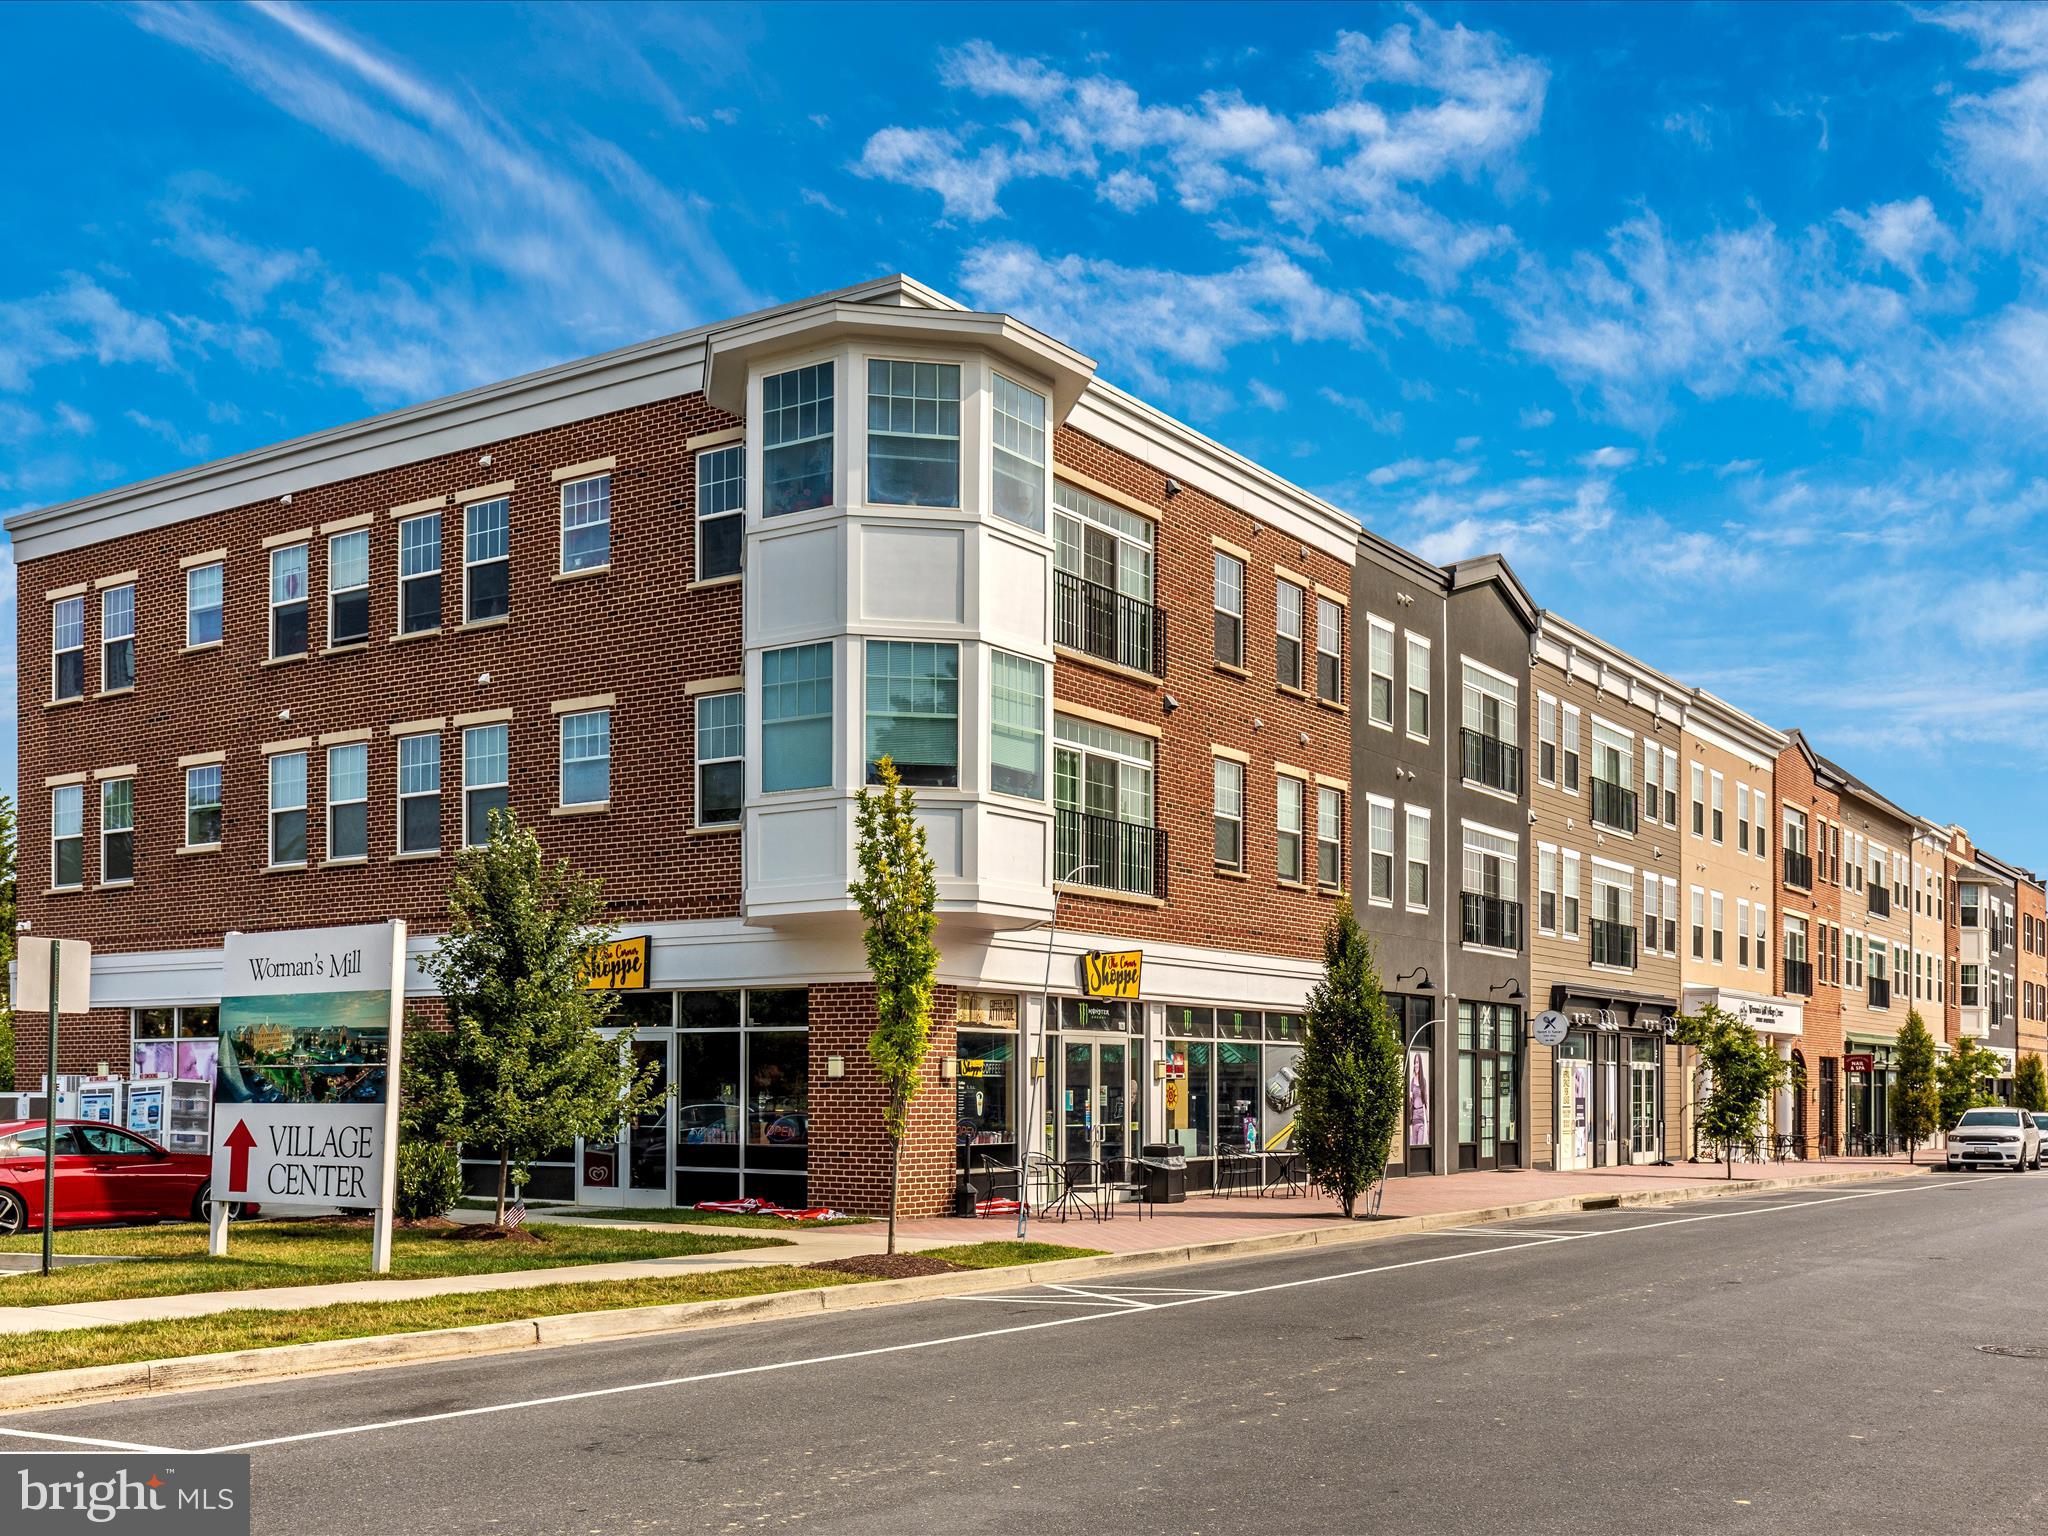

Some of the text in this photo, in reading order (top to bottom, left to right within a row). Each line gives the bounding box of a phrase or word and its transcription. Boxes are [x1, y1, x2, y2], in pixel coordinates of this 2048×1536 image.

[249, 949, 361, 981] Worman's Mill
[1091, 950, 1139, 996] Shoppe
[988, 1007, 1015, 1021] ATTITUDE
[1088, 1008, 1110, 1016] MONSTER
[268, 1125, 373, 1159] VILLAGE
[766, 1125, 795, 1137] OPEN
[267, 1163, 367, 1199] CENTER
